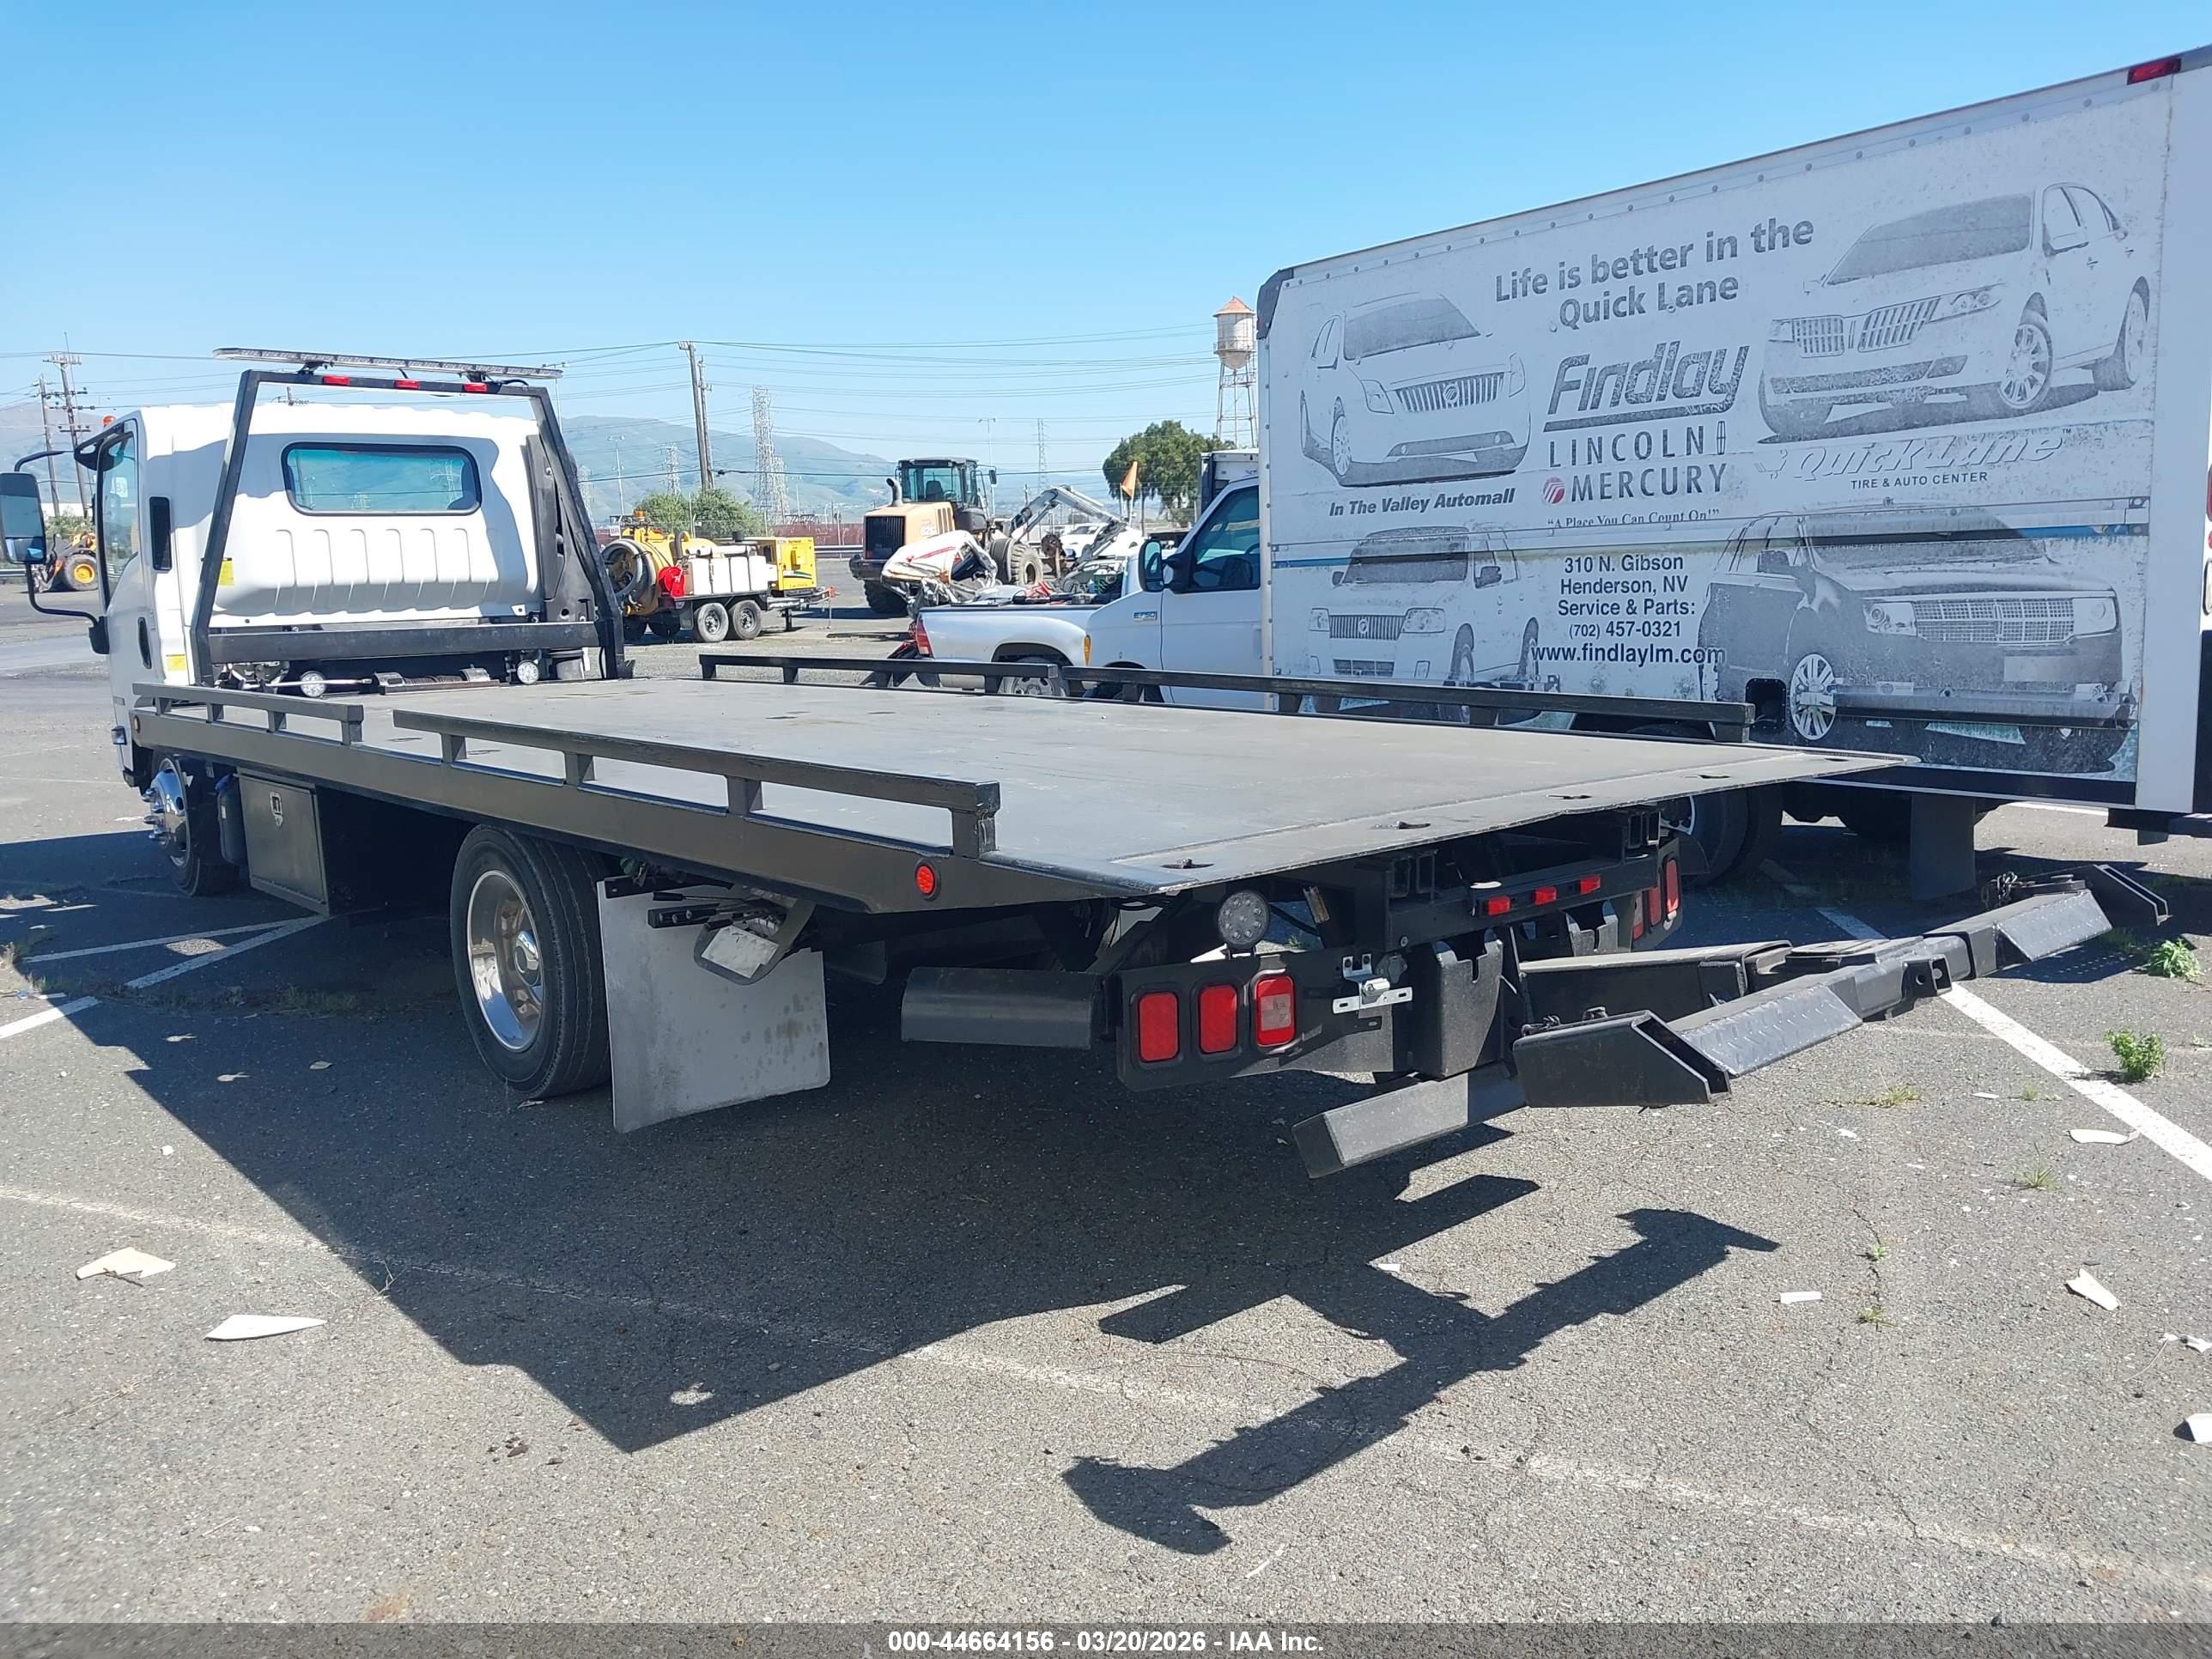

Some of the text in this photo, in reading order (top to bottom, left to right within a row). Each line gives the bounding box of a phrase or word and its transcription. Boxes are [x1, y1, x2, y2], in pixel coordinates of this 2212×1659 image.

[1496, 217, 1814, 302] Life is better in the
[1559, 276, 1739, 330] Quick Lane
[1547, 340, 1750, 416] Findlay
[1549, 425, 1705, 468] LINCOLN
[1571, 463, 1727, 502] MERCURY
[1850, 471, 1988, 489] TIRE & AUTO CENTER
[1329, 487, 1516, 516] In The Valley Automall
[1565, 517, 1594, 528] Place
[1597, 514, 1618, 526] You
[1622, 514, 1645, 525] Can
[1649, 511, 1684, 523] Count
[1565, 554, 1684, 574] 310 N. Gibson
[1560, 575, 1689, 596] Henderson, NV
[1558, 599, 1696, 617] Service & Parts:
[1569, 620, 1681, 641] (702) 457-0321
[1531, 643, 1726, 668] www.findlaylm.com
